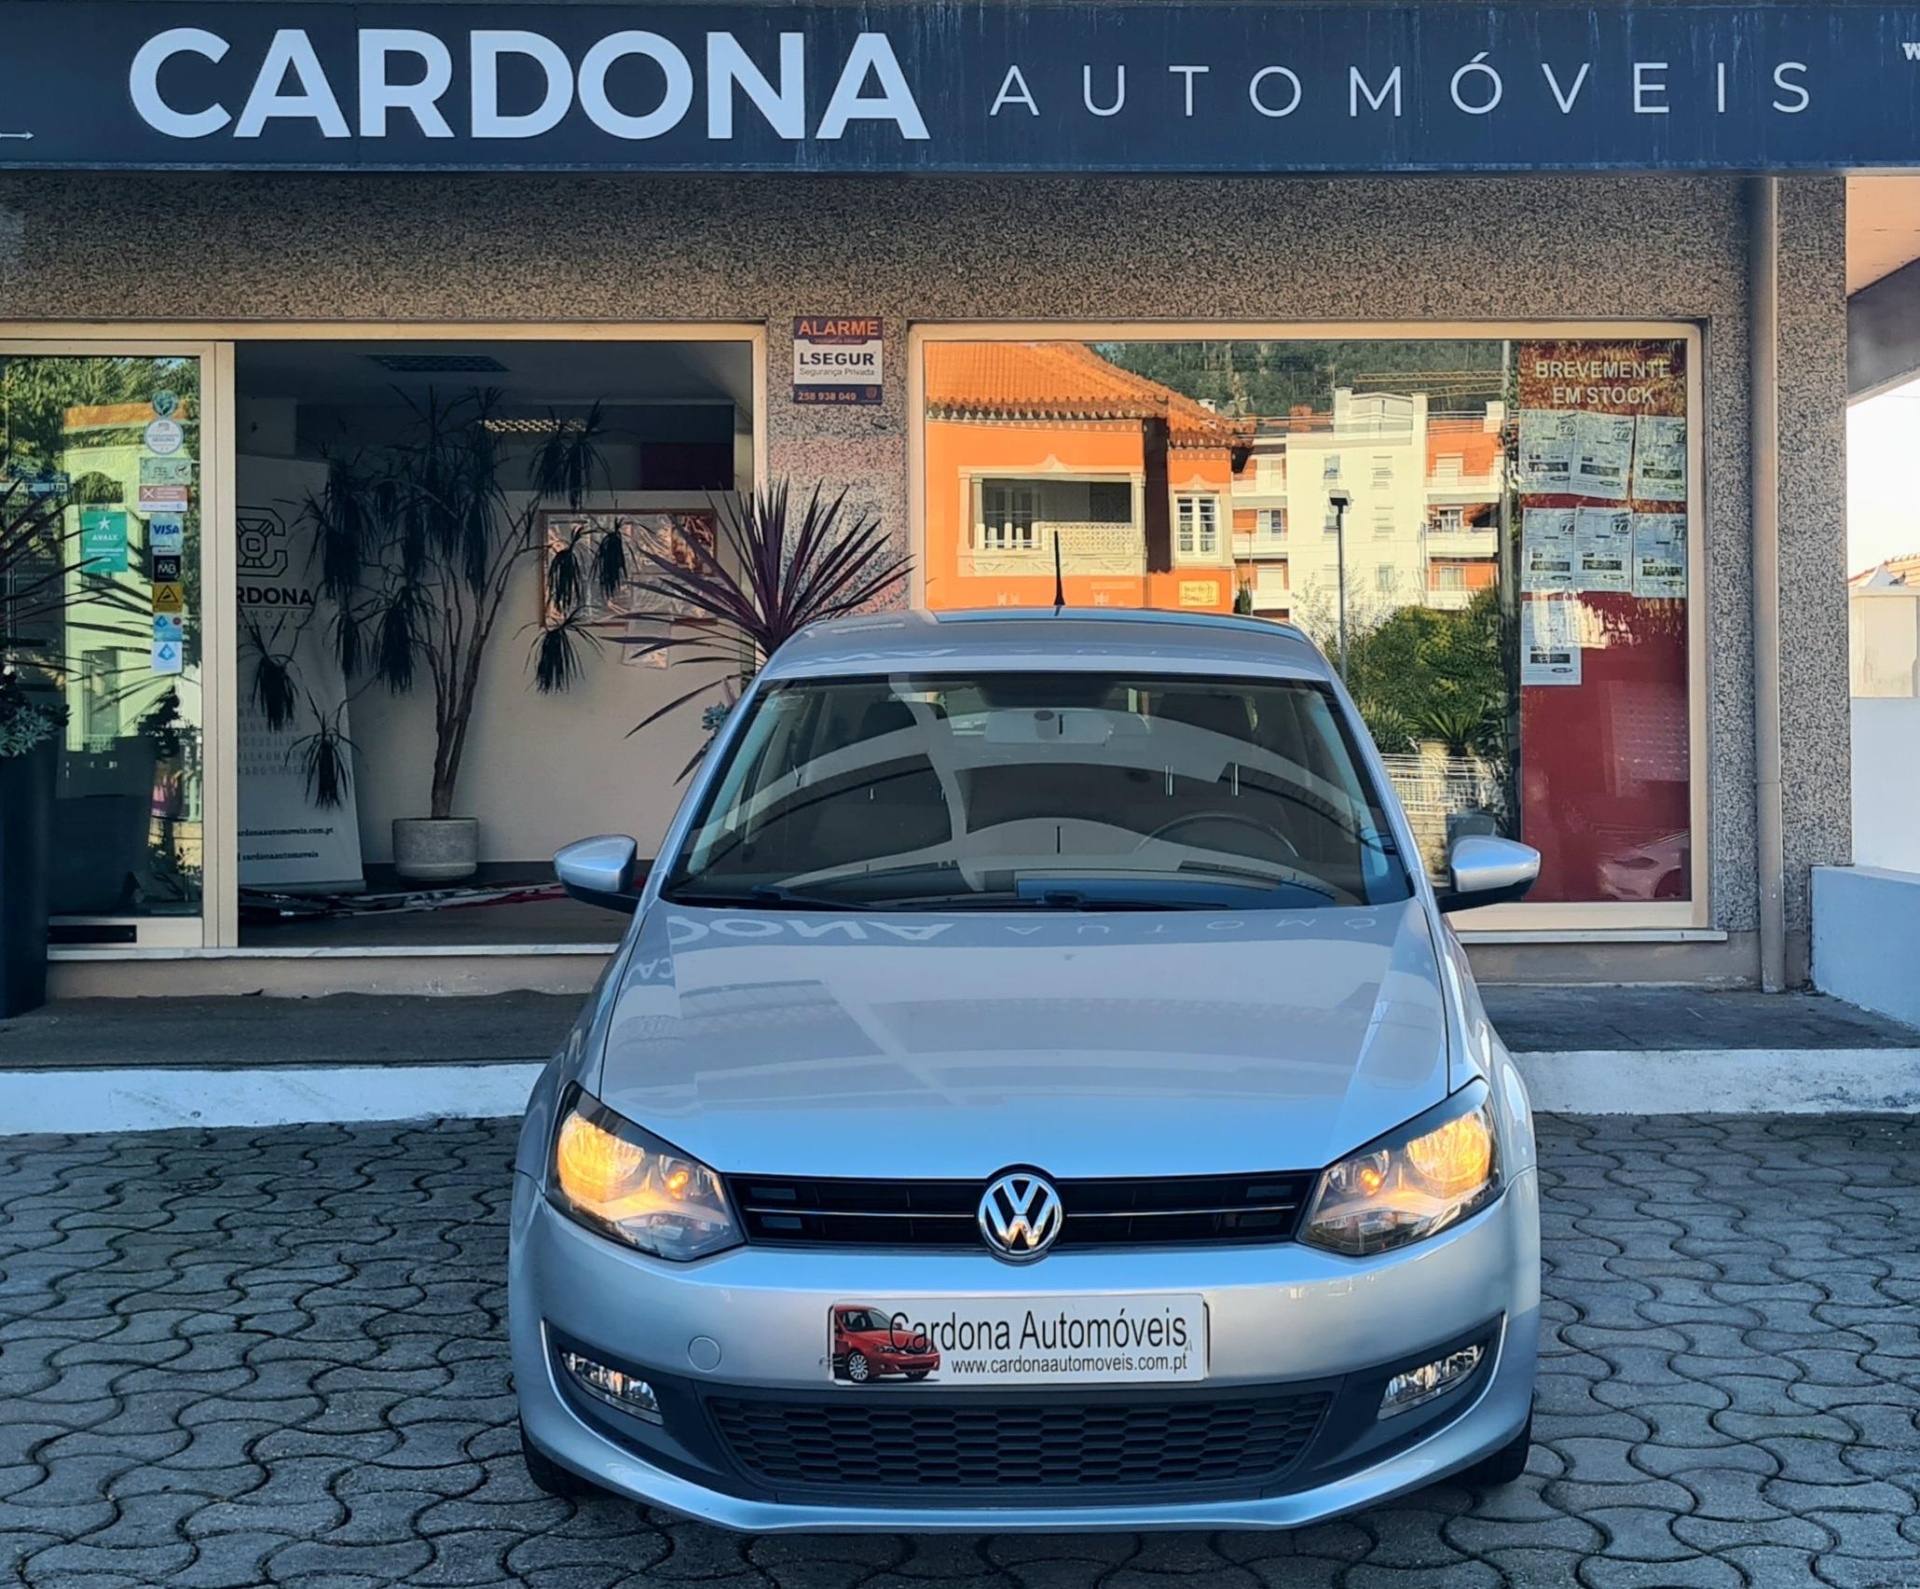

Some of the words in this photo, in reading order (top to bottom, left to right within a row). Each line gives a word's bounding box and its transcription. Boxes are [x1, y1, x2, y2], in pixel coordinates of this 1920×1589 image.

[129, 28, 931, 139] CARDONA
[990, 52, 1809, 117] AUTOMÓVEIS
[798, 321, 878, 336] ALARME
[799, 352, 874, 366] LSEGUR
[1535, 360, 1671, 379] BREVEMENTE
[1553, 387, 1581, 404] EM
[1586, 386, 1656, 404] STOCK
[153, 524, 180, 535] VISA
[977, 1172, 1064, 1256] VW
[890, 1311, 1010, 1353] Cardona
[1020, 1308, 1187, 1350] Automóveis
[951, 1352, 1188, 1374] www.cardonaautomoveis.com.pt
